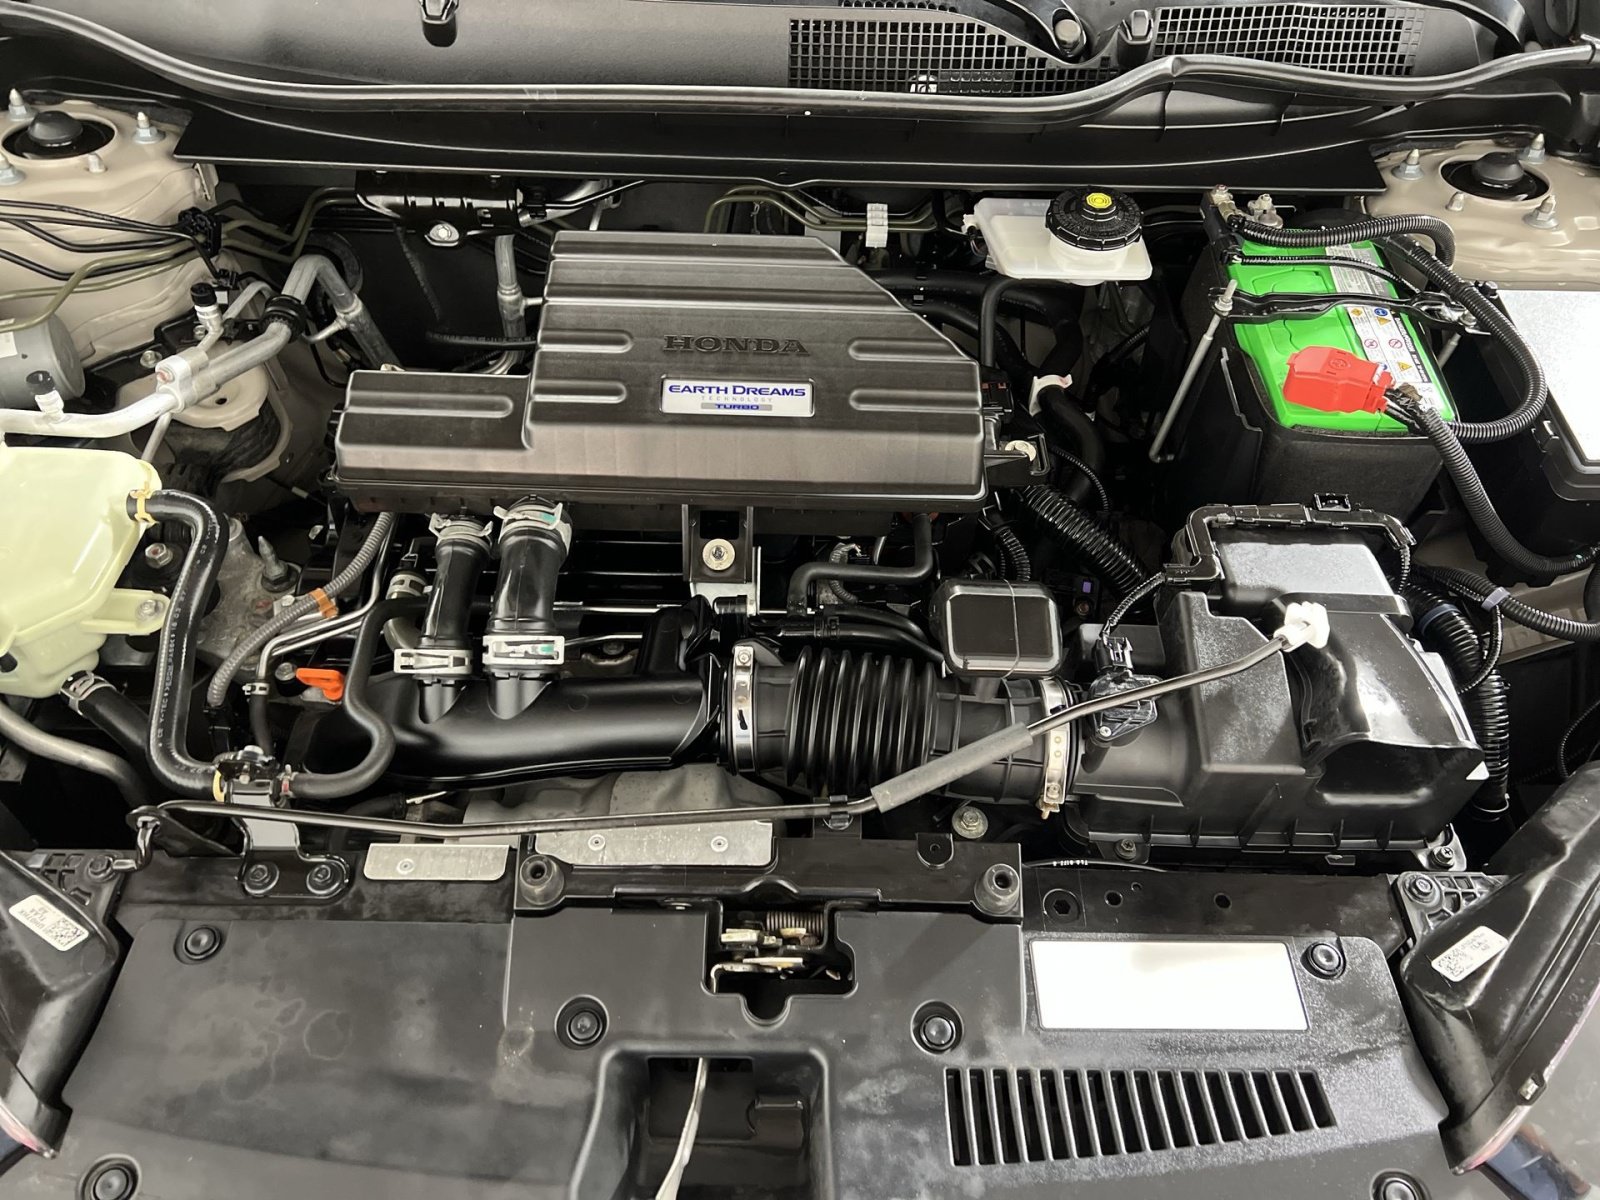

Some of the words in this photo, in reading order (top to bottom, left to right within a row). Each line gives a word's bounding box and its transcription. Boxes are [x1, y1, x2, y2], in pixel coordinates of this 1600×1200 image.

[664, 334, 811, 357] HONDA
[668, 384, 728, 395] EARTH
[732, 385, 806, 397] DREAMS
[715, 403, 760, 411] TURBO
